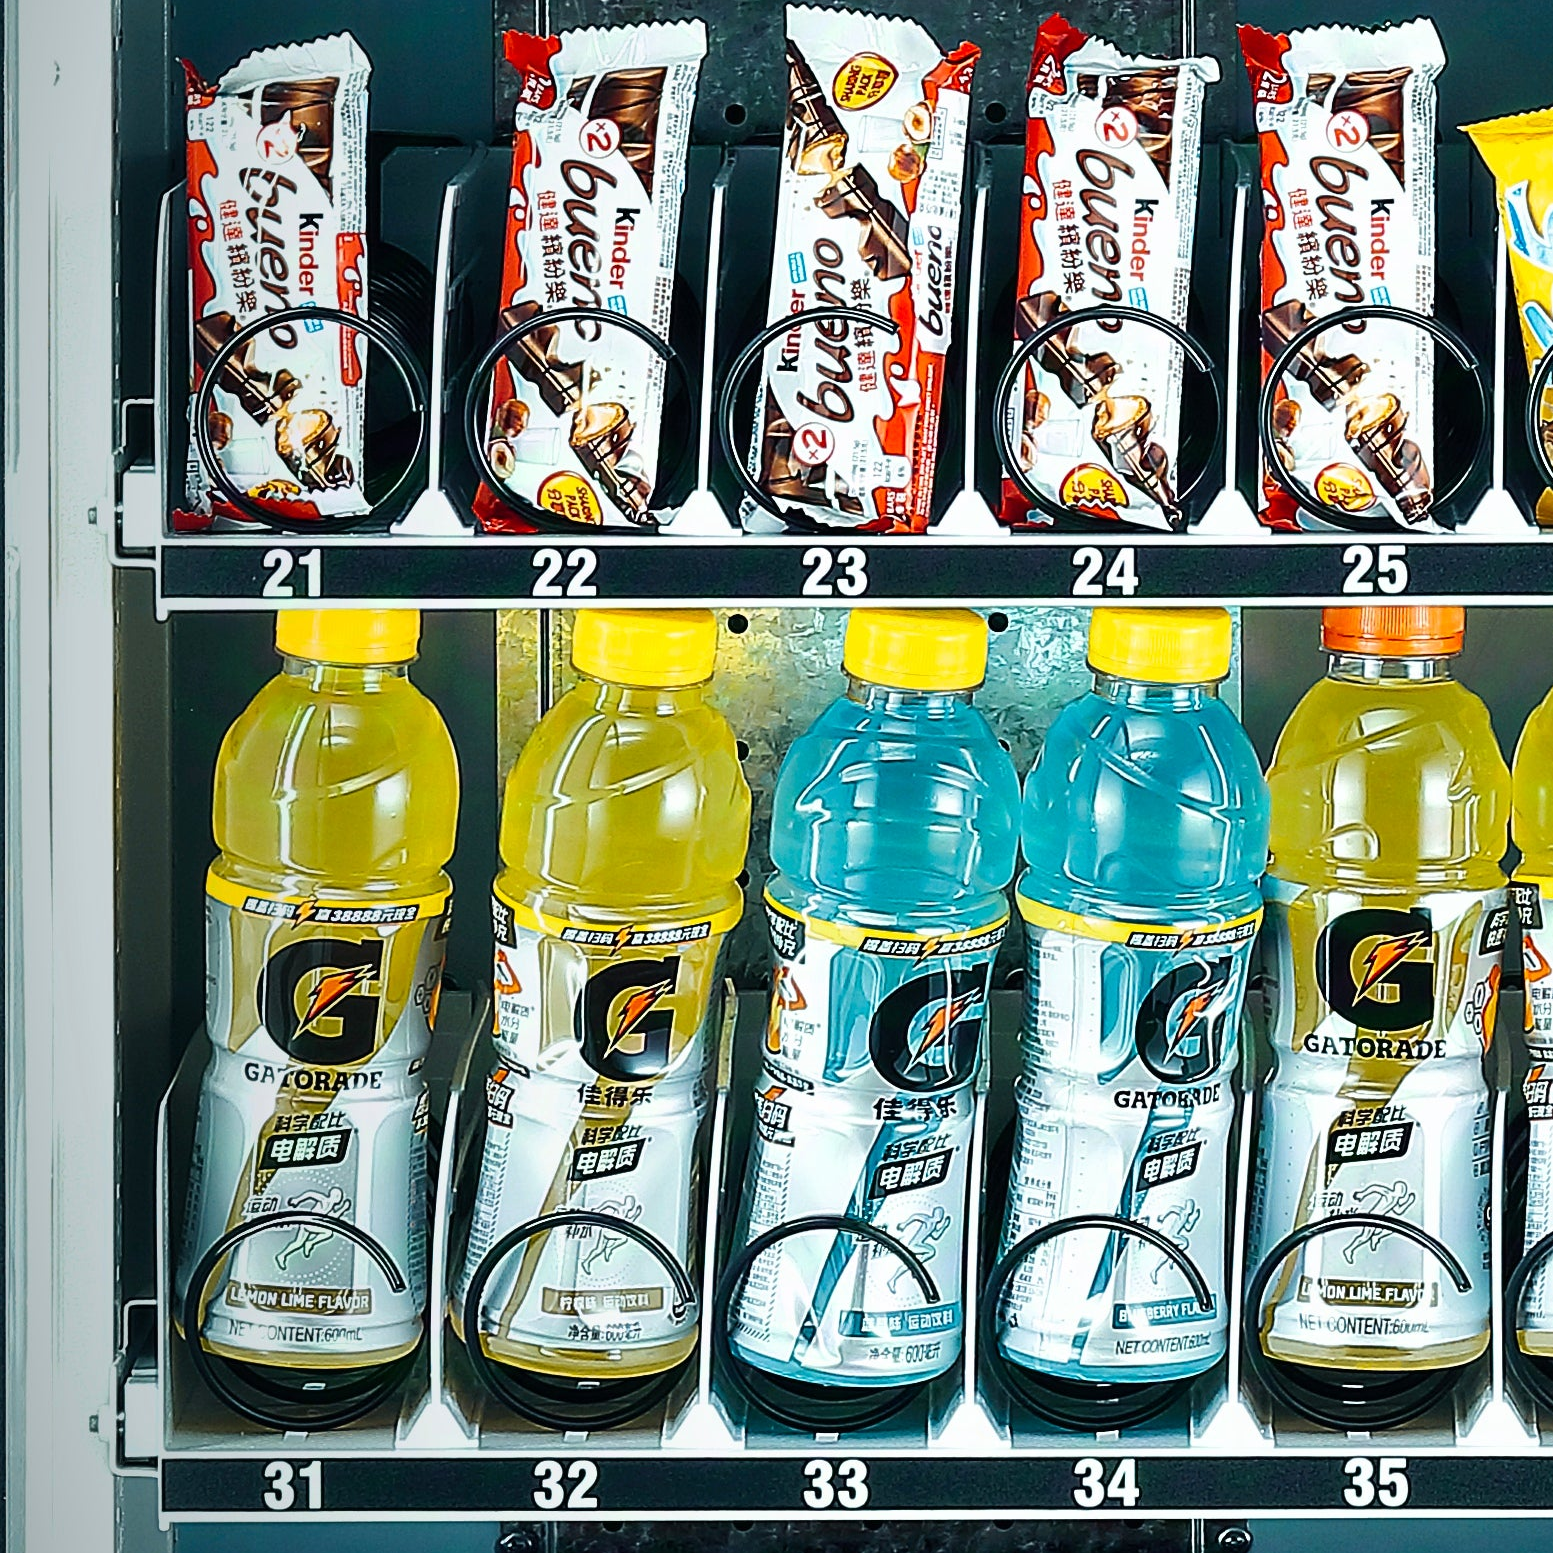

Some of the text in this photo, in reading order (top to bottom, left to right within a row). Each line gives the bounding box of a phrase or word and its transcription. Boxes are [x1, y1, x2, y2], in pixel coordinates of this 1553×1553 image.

[240, 167, 298, 349] bueno
[299, 213, 318, 297] Kinder
[561, 157, 618, 343] bueno
[609, 207, 641, 291] Kinder
[1075, 149, 1136, 333] bueno
[1129, 197, 1159, 282] Kinder
[1310, 155, 1369, 335] bueno
[1367, 198, 1394, 281] Kinder
[796, 237, 855, 424] bueno
[263, 549, 320, 596] 21
[533, 549, 596, 596] 22
[803, 548, 867, 595] 23
[1073, 547, 1138, 595] 24
[1343, 545, 1407, 593] 25
[1304, 1033, 1447, 1059] GATORADE
[244, 1063, 384, 1091] GATORADE
[577, 1083, 654, 1108] 佳得乐
[1113, 1083, 1221, 1110] GATORADE
[274, 1112, 346, 1133] 科学配比
[873, 1096, 957, 1122] 佳得乐
[1337, 1104, 1407, 1127] 科学配比
[270, 1136, 342, 1162] 电解质
[577, 1144, 637, 1176] 电解质
[1143, 1148, 1196, 1183] 电解质
[1335, 1128, 1404, 1157] 电解质
[879, 1156, 946, 1190] 电解质
[281, 1288, 315, 1309] LIME
[318, 1289, 369, 1311] FLAVOR
[1349, 1281, 1382, 1301] LIME
[1115, 1340, 1140, 1355] NET
[264, 1461, 321, 1509] 31
[534, 1461, 597, 1508] 32
[804, 1460, 868, 1508] 33
[1074, 1459, 1139, 1507] 34
[1344, 1458, 1408, 1506] 35
